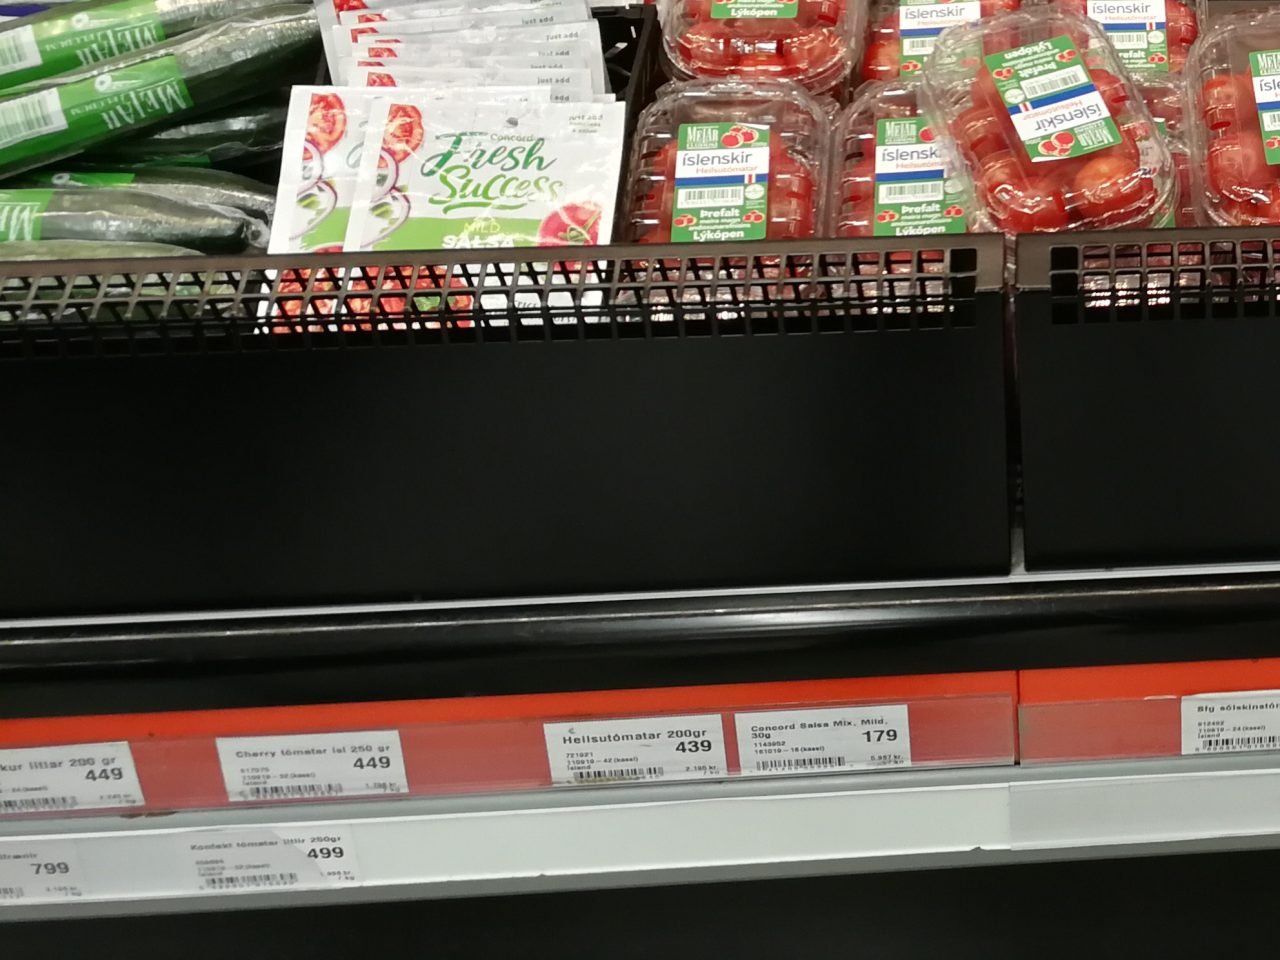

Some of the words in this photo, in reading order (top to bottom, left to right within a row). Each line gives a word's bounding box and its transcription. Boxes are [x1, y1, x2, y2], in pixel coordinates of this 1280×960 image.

[730, 8, 778, 17] Lýkópen
[904, 6, 965, 19] íslenskir
[1091, 2, 1151, 14] íslenskir
[1004, 40, 1052, 59] Lýkópen
[1018, 62, 1057, 77] Þrefalt
[1034, 104, 1102, 132] íslenskir
[490, 133, 534, 142] Concord
[421, 131, 556, 177] Fresh
[682, 151, 752, 166] íslenskir
[428, 165, 567, 214] Success
[700, 208, 740, 218] Þrefalt
[901, 203, 941, 214] Þrefalt
[464, 221, 501, 233] MILD
[693, 229, 745, 240] Lýkópen
[752, 723, 795, 731] Concord
[563, 733, 661, 744] Heilsutómatar
[667, 730, 707, 738] 200gr
[862, 729, 897, 742] 179
[281, 748, 326, 756] tómatar
[675, 740, 712, 753] 439
[353, 756, 391, 769] 449
[86, 768, 123, 781] 449
[307, 847, 344, 859] 499
[30, 862, 69, 874] 799
